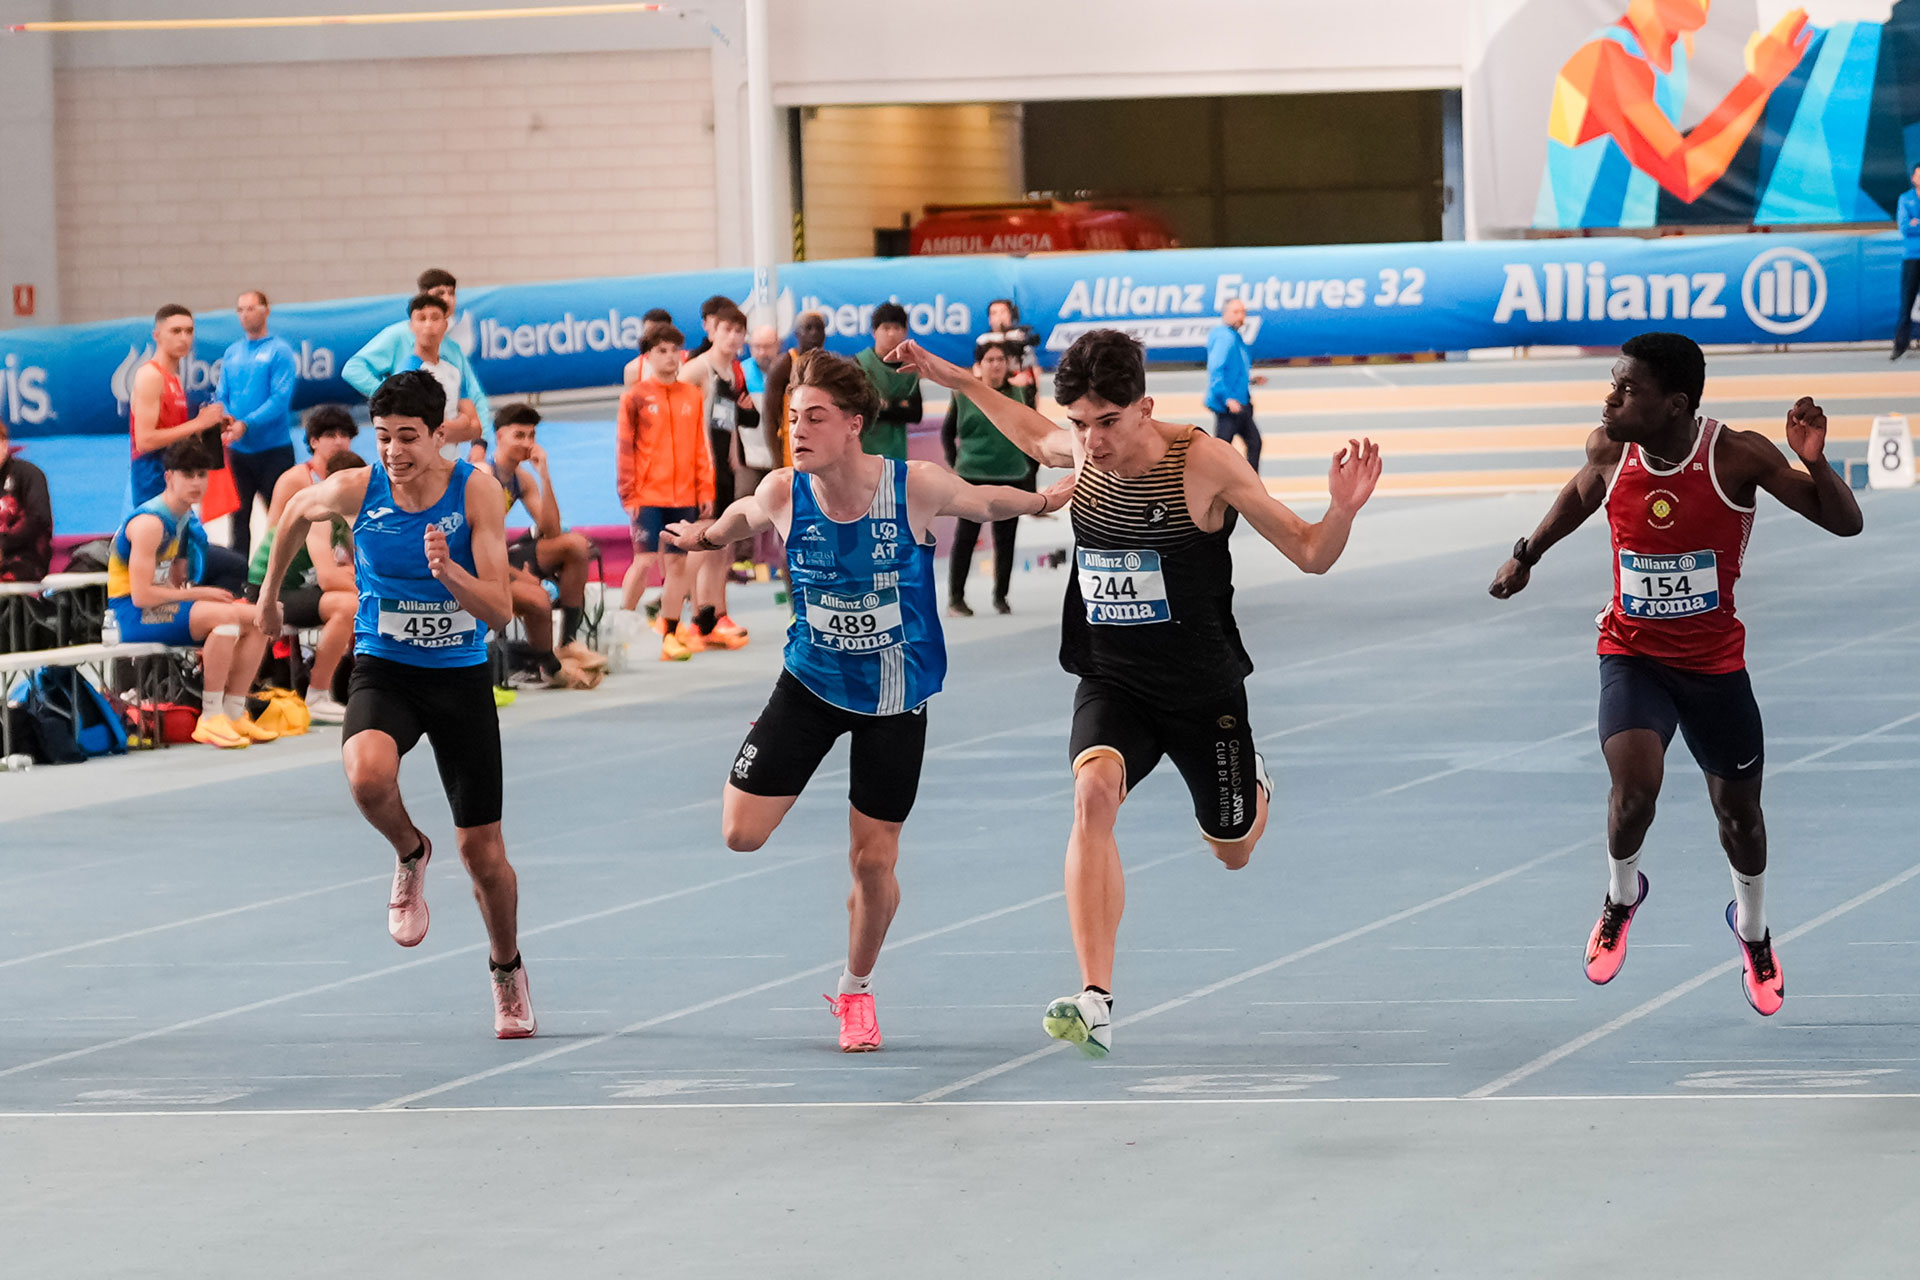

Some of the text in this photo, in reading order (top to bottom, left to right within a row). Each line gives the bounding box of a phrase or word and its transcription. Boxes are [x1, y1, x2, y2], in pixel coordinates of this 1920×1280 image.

[920, 233, 1052, 252] AMBULANCIA
[1058, 267, 1426, 319] Allianz Futures 32
[1492, 261, 1727, 323] Allianz
[480, 308, 644, 360] Iberdrola
[0, 352, 51, 425] is
[1882, 439, 1901, 470] 8
[1085, 553, 1122, 568] Allianz
[1632, 557, 1677, 570] Allianz
[1092, 575, 1138, 600] 244
[1641, 575, 1692, 597] 154
[397, 600, 441, 610] Allianz
[820, 593, 861, 609] Allianz
[404, 617, 452, 637] 459
[828, 614, 876, 634] 489
[1215, 741, 1230, 827] CLUB DE ATLETISMO
